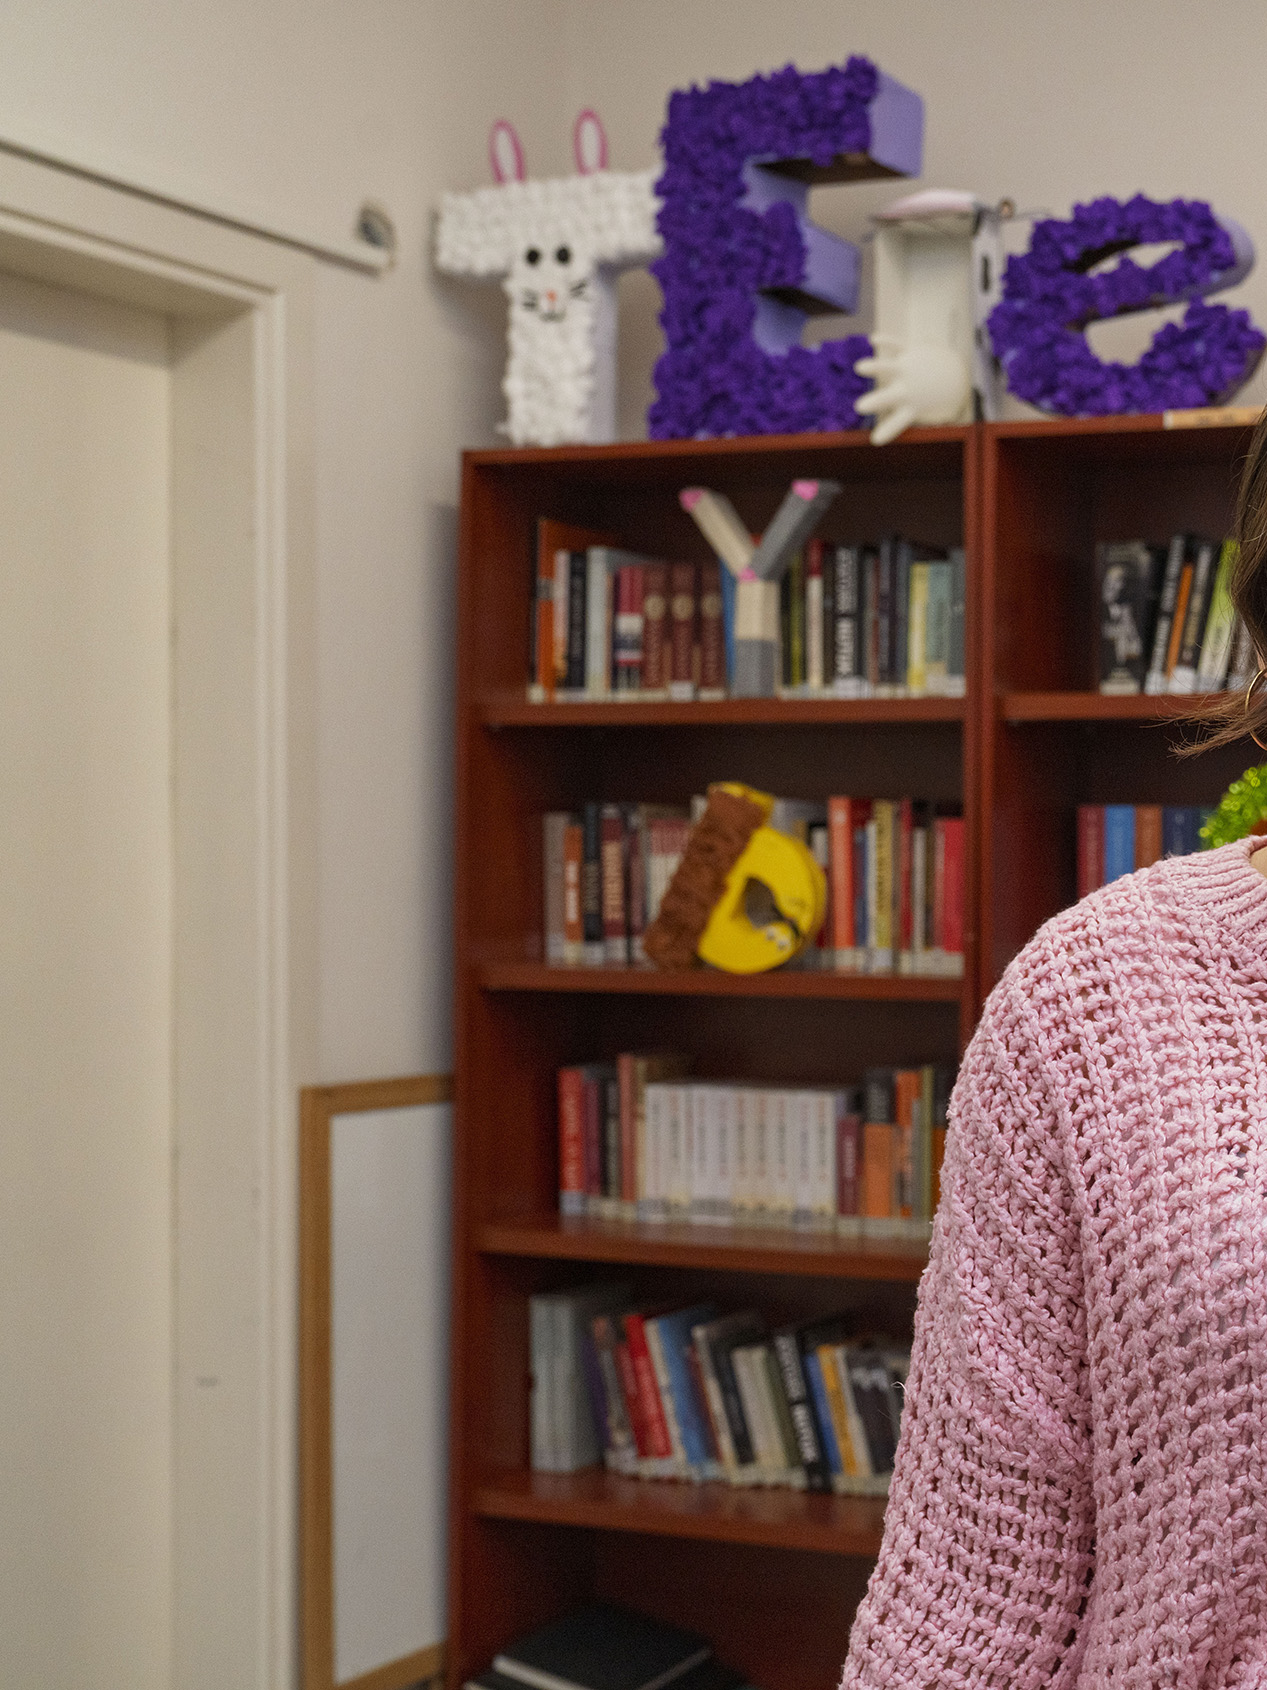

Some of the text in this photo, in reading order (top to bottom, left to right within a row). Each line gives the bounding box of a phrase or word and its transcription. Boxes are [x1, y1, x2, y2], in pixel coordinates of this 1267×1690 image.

[434, 168, 664, 446] T
[650, 55, 925, 440] E
[678, 478, 842, 698] Y
